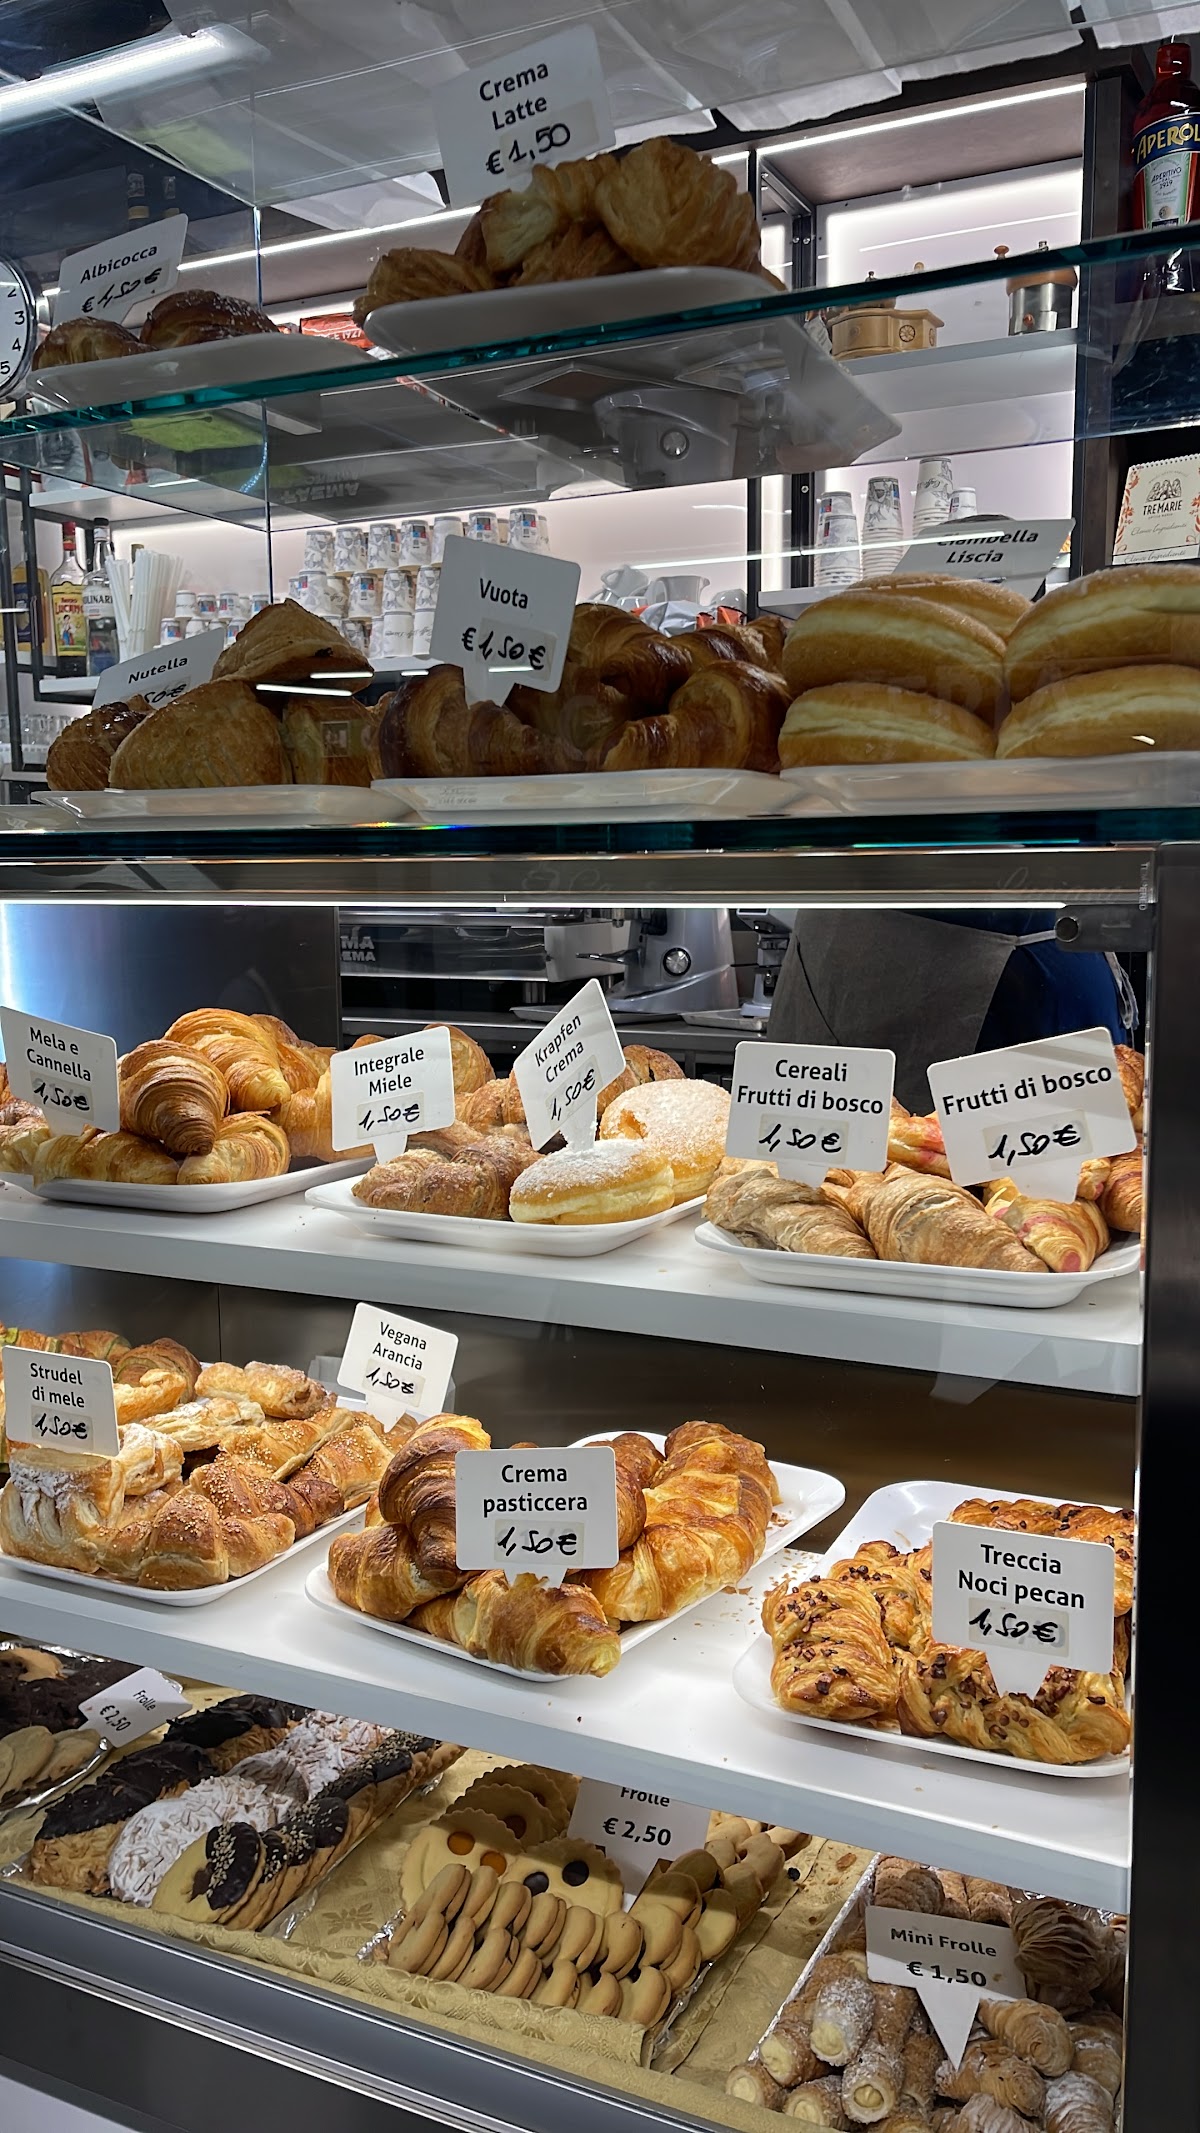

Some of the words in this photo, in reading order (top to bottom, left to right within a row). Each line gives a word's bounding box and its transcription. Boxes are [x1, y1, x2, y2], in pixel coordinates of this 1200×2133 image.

[480, 63, 548, 101] Crema
[492, 97, 547, 130] Latte
[1136, 123, 1200, 164] APEROL
[80, 246, 157, 284] Albicocca
[15, 311, 25, 325] 3
[12, 338, 21, 351] 4
[0, 361, 10, 374] 5
[945, 550, 1004, 564] Liscia
[480, 578, 528, 609] Vuota
[128, 657, 188, 684] Nutella
[30, 1027, 65, 1051] Mela
[70, 1043, 79, 1055] e
[534, 1015, 582, 1067] Krapfen
[27, 1048, 91, 1082] Cannella
[354, 1047, 424, 1076] Integrale
[545, 1041, 585, 1083] Crema
[775, 1059, 847, 1082] Cereali
[369, 1074, 412, 1096] Miele
[942, 1084, 1009, 1116] Frutti
[1014, 1077, 1037, 1100] di
[1041, 1066, 1112, 1094] bosco
[737, 1085, 791, 1107] Frutti
[797, 1089, 816, 1109] di
[822, 1091, 883, 1115] bosco
[380, 1321, 427, 1350] Vegana
[372, 1342, 423, 1370] Arancia
[30, 1362, 83, 1385] Strudel
[32, 1386, 45, 1401] di
[49, 1392, 85, 1408] mele
[501, 1464, 568, 1483] Crema
[483, 1492, 588, 1518] pasticcera
[980, 1543, 1062, 1575] Treccia
[958, 1569, 1007, 1596] Noci
[1014, 1583, 1085, 1609] pecan
[133, 1689, 157, 1711] Frolle
[620, 1786, 670, 1808] Frolle
[890, 1928, 933, 1946] Mini
[939, 1935, 997, 1957] Frolle
